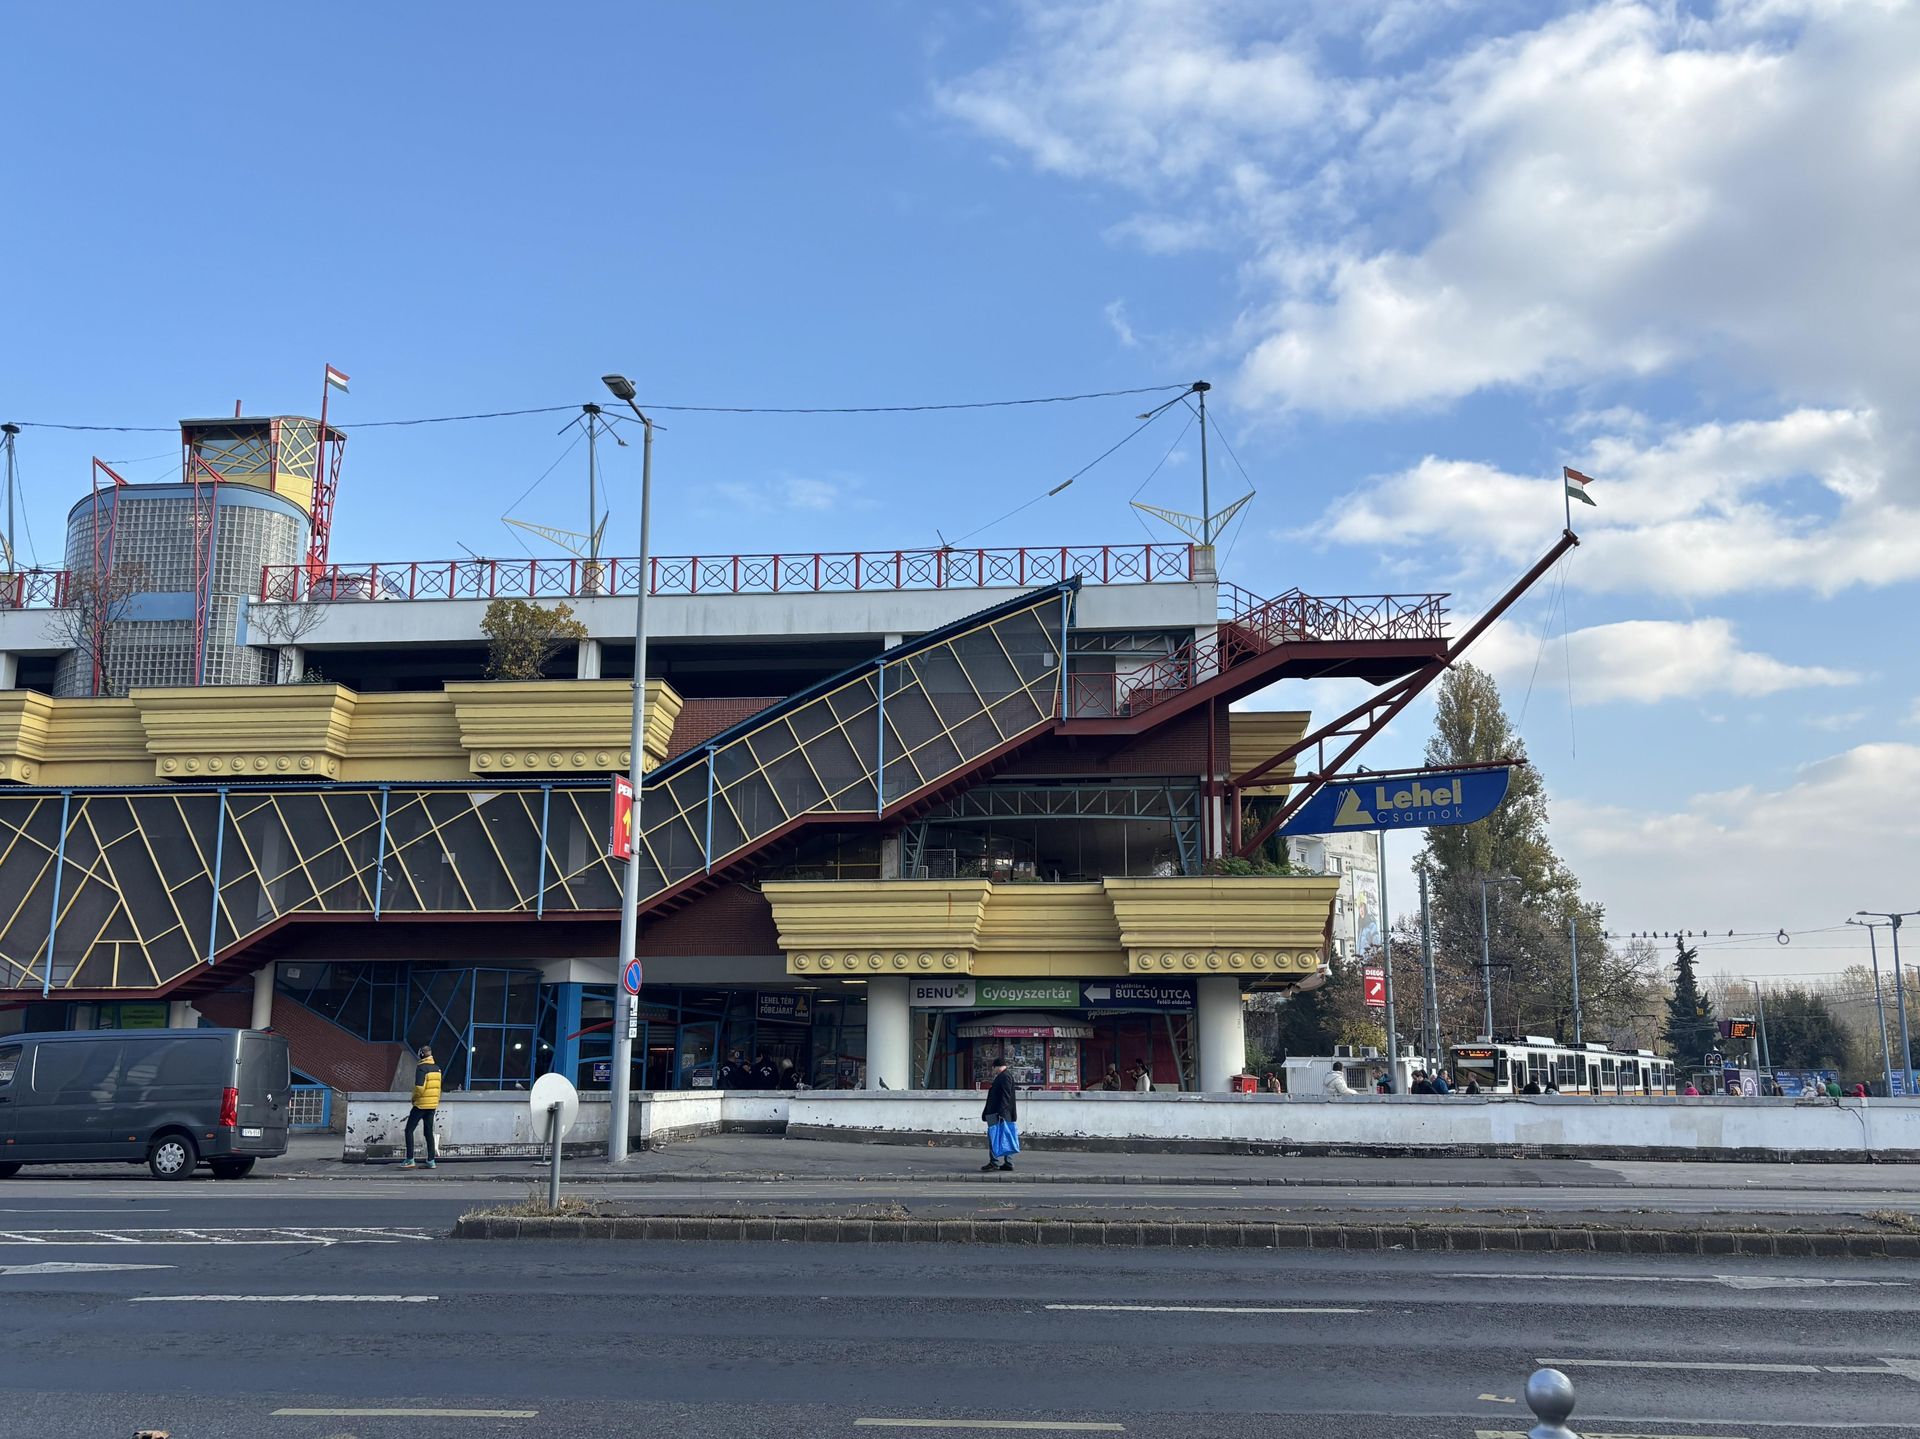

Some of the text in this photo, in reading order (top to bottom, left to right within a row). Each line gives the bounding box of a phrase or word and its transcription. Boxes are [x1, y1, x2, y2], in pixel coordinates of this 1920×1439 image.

[1375, 779, 1462, 809] Lehel
[1377, 807, 1462, 823] Csarnok
[917, 988, 953, 998] BENU
[983, 986, 1072, 1001] Gyógyszertár
[1115, 987, 1191, 999] BULCSÚ UTCA
[780, 996, 794, 1004] TÉRI
[761, 1004, 793, 1014] FŐBEJÁRAT
